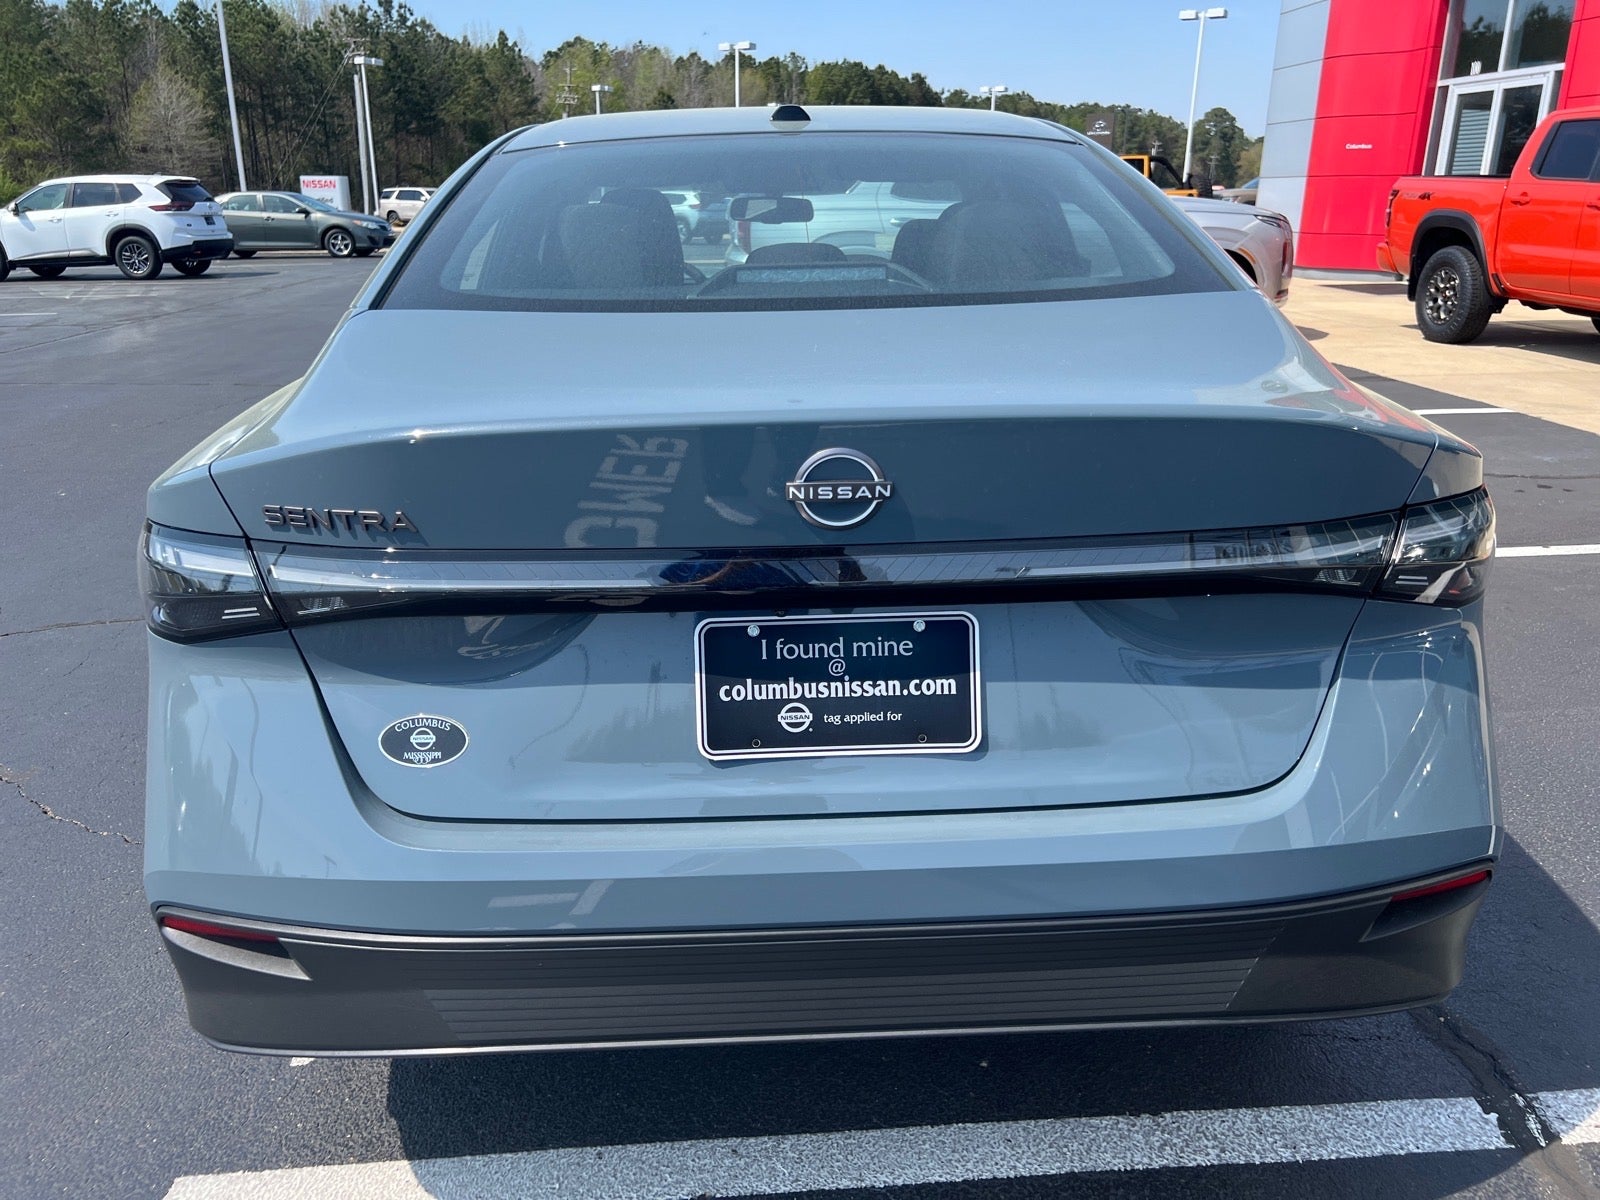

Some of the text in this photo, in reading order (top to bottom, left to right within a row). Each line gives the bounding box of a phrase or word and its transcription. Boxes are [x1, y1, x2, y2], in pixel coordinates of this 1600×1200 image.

[302, 179, 337, 189] NISSAN
[788, 484, 892, 500] NISSAN
[262, 503, 419, 533] SENTRA
[761, 636, 914, 660] I found mine
[828, 658, 846, 677] @
[718, 675, 957, 702] columbusnissan.com
[394, 718, 451, 732] COLUMBUS
[823, 711, 903, 725] tag applied for
[402, 751, 442, 760] MISSISSIPPI
